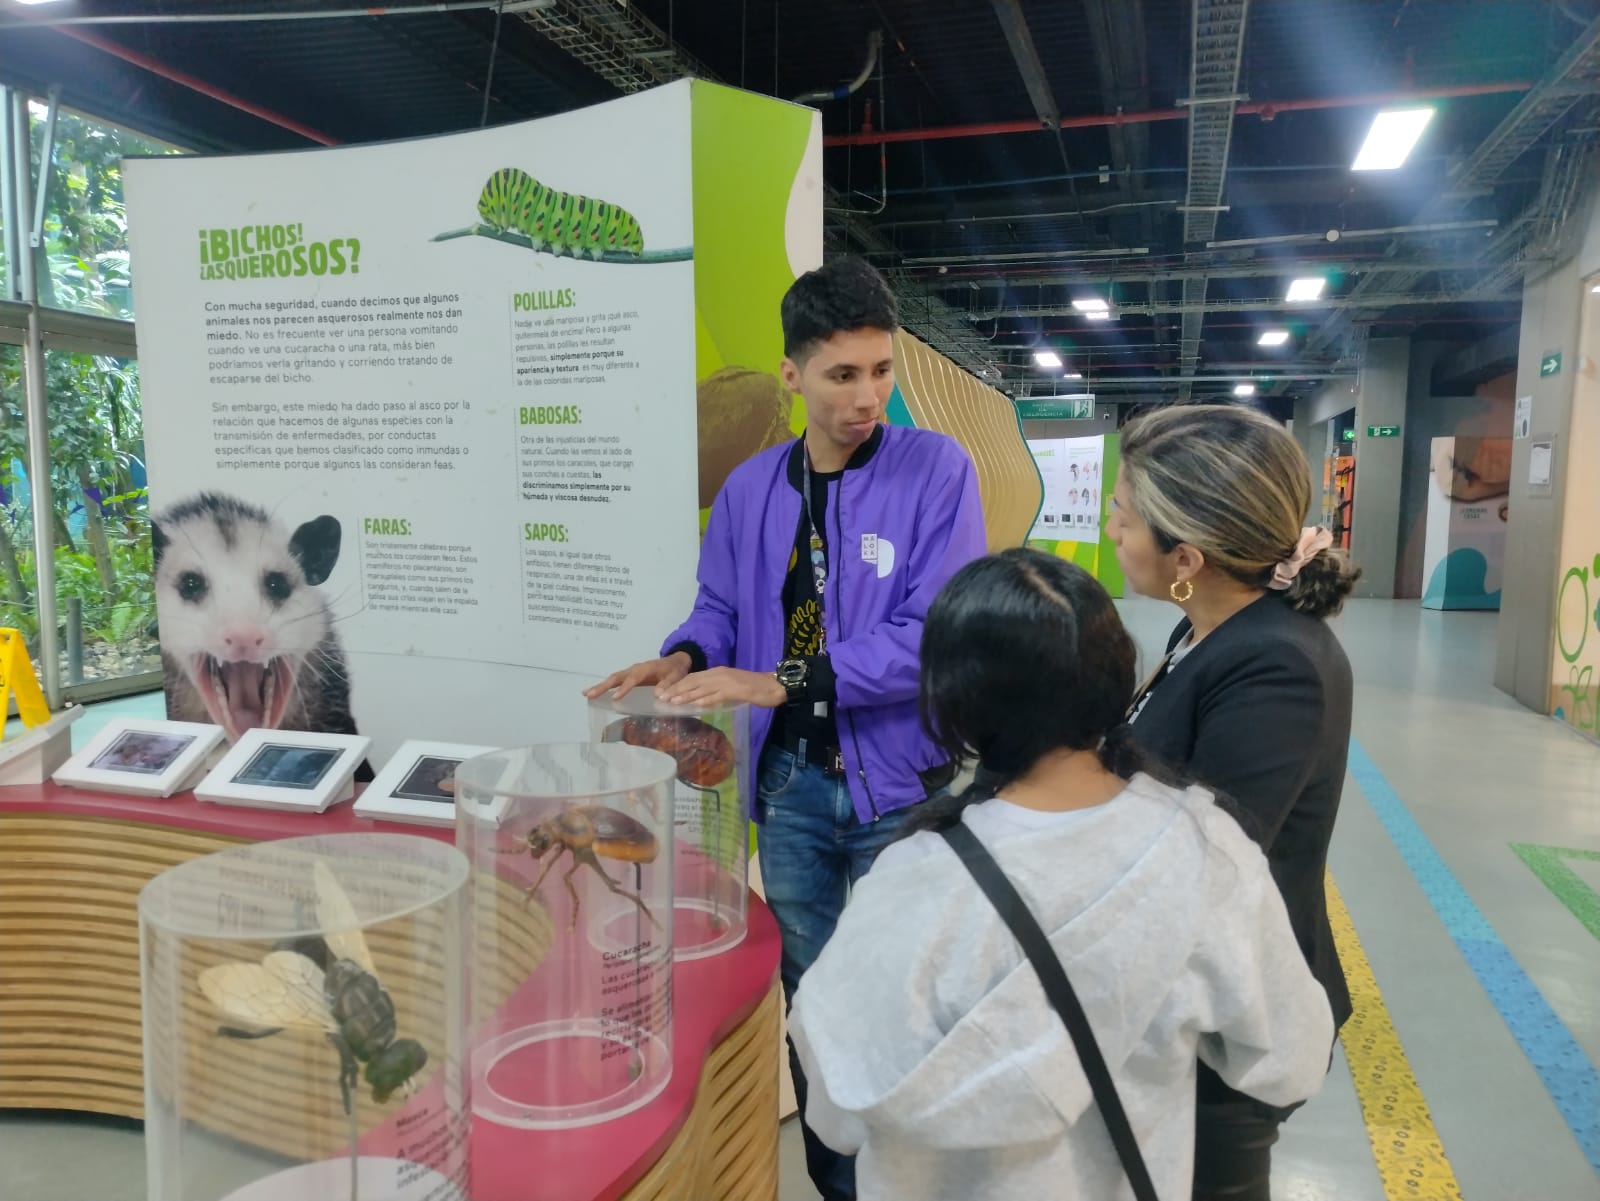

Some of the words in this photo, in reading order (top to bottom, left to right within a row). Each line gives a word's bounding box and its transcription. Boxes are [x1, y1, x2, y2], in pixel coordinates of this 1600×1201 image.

[199, 223, 303, 264] ¡BICHOS!
[200, 238, 361, 281] ¿ASQUEROSOS?
[204, 302, 226, 312] Con
[228, 302, 262, 310] mucha
[265, 300, 318, 311] seguridad,
[321, 298, 357, 308] cuando
[360, 297, 400, 307] decimos
[403, 297, 420, 306] que
[423, 294, 459, 305] algunos
[514, 288, 576, 312] POLILLAS:
[206, 316, 250, 326] animales
[274, 316, 314, 325] parecen
[318, 314, 374, 324] asquerosos
[376, 311, 424, 320] realmente
[426, 310, 443, 319] nos
[445, 308, 462, 318] dan
[207, 331, 241, 340] miedo.
[244, 330, 260, 340] No
[262, 331, 275, 340] es
[277, 329, 326, 339] frecuente
[347, 329, 365, 337] una
[368, 328, 407, 339] persona
[410, 324, 458, 334] vomitando
[208, 346, 245, 355] cuando
[263, 346, 282, 354] una
[284, 344, 335, 354] cucaracha
[338, 344, 346, 352] o
[348, 344, 366, 352] una
[368, 342, 390, 352] rata,
[393, 341, 413, 350] más
[414, 340, 435, 350] bien
[209, 360, 263, 370] podríamos
[266, 359, 291, 368] verla
[294, 357, 336, 370] gritando
[339, 360, 345, 368] y
[348, 357, 395, 367] corriendo
[398, 356, 438, 365] tratando
[440, 354, 453, 365] de
[550, 353, 591, 361] simplemente
[592, 351, 615, 359] porque
[210, 376, 261, 384] escaparse
[264, 374, 280, 383] del
[282, 373, 313, 383] bicho.
[517, 366, 550, 375] apariencia
[212, 402, 229, 412] Sin
[232, 403, 280, 414] embargo,
[307, 402, 338, 412] miedo
[341, 402, 353, 411] ha
[356, 402, 380, 411] dado
[383, 403, 406, 412] paso
[408, 400, 417, 411] al
[444, 402, 459, 412] por
[462, 400, 470, 410] la
[520, 406, 582, 424] BABOSAS:
[213, 417, 254, 426] relación
[257, 418, 276, 427] que
[279, 417, 324, 426] hacemos
[326, 416, 339, 426] de
[342, 417, 379, 428] algunas
[382, 416, 423, 426] especies
[445, 415, 453, 424] la
[214, 431, 273, 440] transmisión
[276, 431, 289, 440] de
[292, 431, 365, 440] enfermedades,
[368, 432, 384, 441] por
[388, 431, 436, 440] conductas
[215, 445, 272, 455] específicas
[275, 447, 294, 456] que
[333, 445, 384, 455] clasificado
[416, 446, 460, 455] inmundas
[217, 460, 281, 469] simplemente
[284, 461, 320, 470] porque
[323, 460, 360, 471] algunos
[363, 459, 377, 469] las
[380, 460, 431, 469] consideran
[434, 460, 455, 470] feas.
[364, 518, 412, 535] FARAS:
[525, 523, 569, 542] SAPOS:
